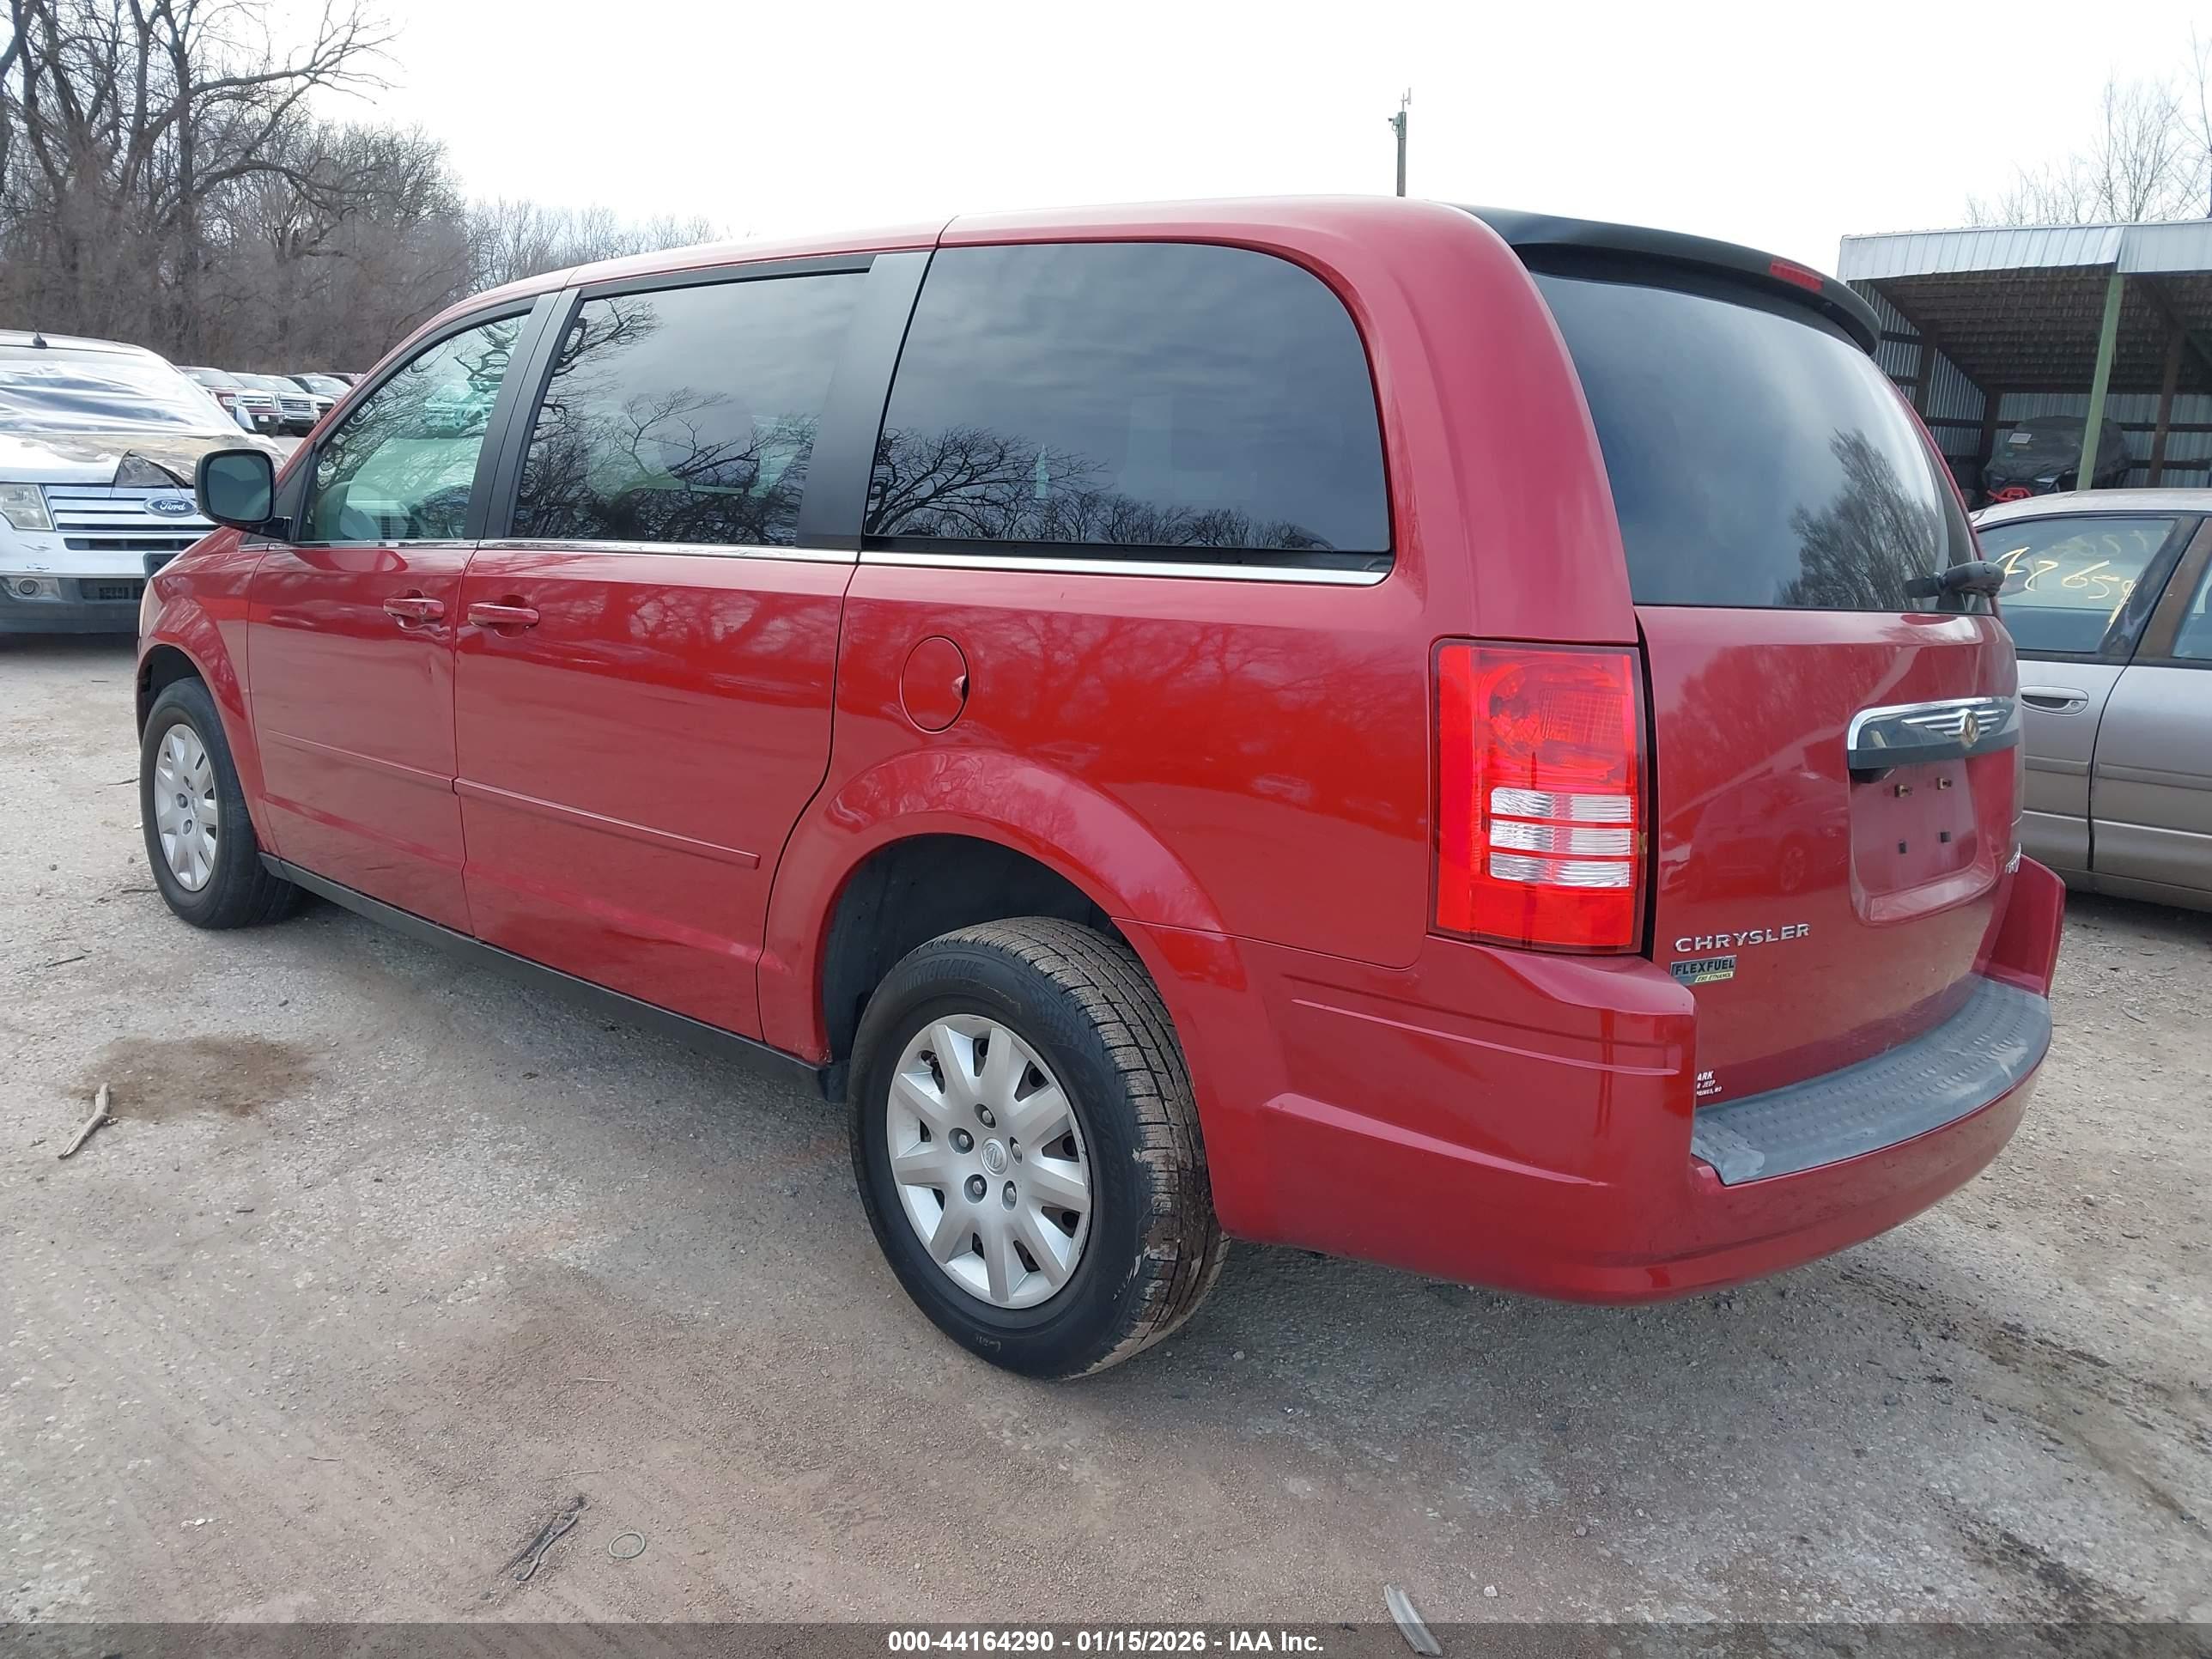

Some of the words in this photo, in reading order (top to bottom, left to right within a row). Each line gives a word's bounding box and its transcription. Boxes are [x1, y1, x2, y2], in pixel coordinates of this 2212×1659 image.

[159, 500, 186, 512] Ford
[1674, 924, 1810, 952] CHRYSLER
[1675, 959, 1735, 975] FLEXFUEL
